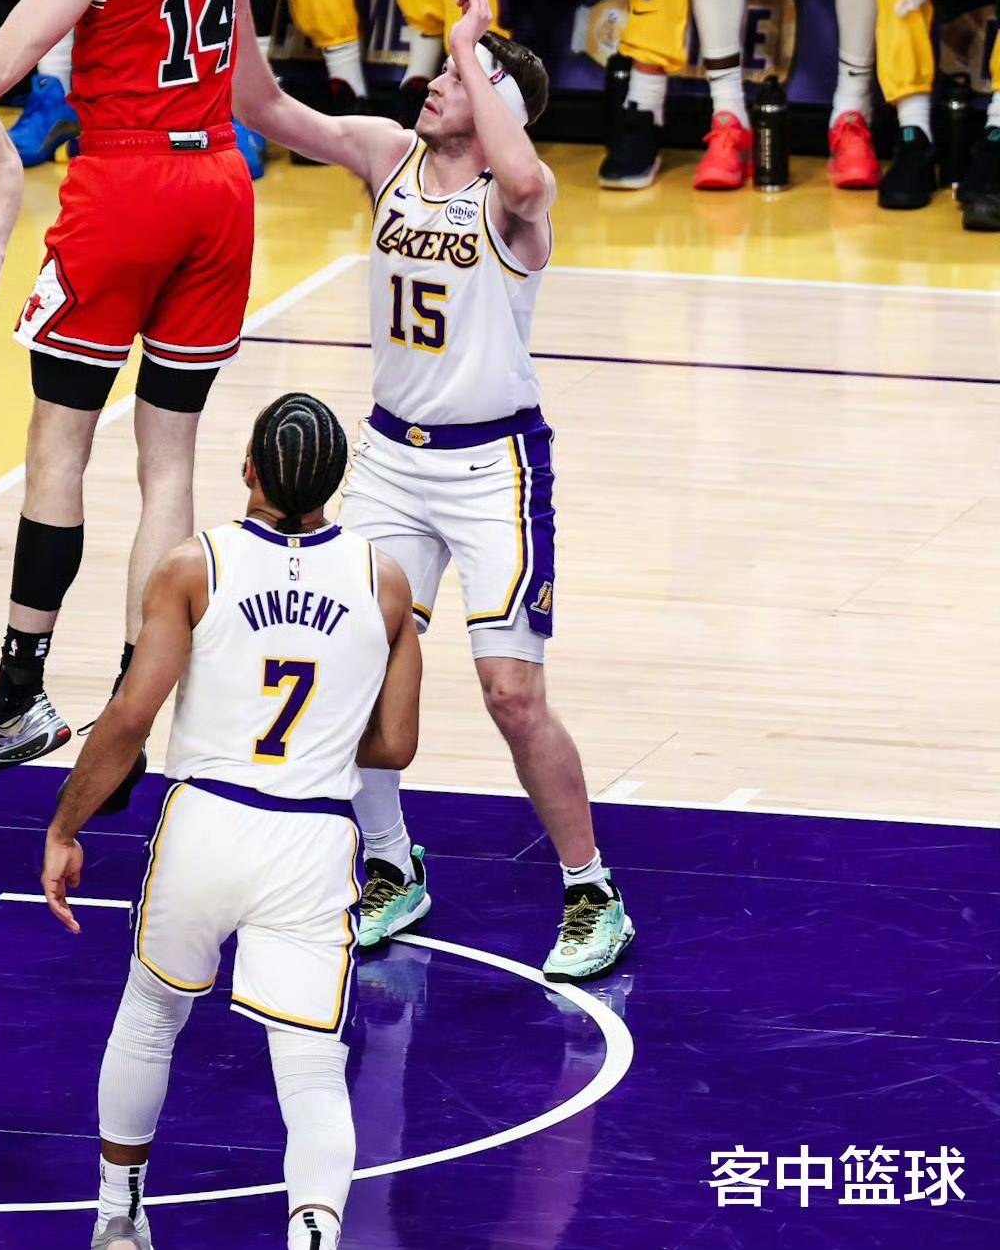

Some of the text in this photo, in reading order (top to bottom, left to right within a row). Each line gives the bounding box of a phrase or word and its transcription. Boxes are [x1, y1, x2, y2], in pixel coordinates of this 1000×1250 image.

[376, 208, 480, 269] LAKERS
[389, 273, 449, 356] 15
[238, 590, 350, 636] VINCENT
[252, 654, 320, 766] 7
